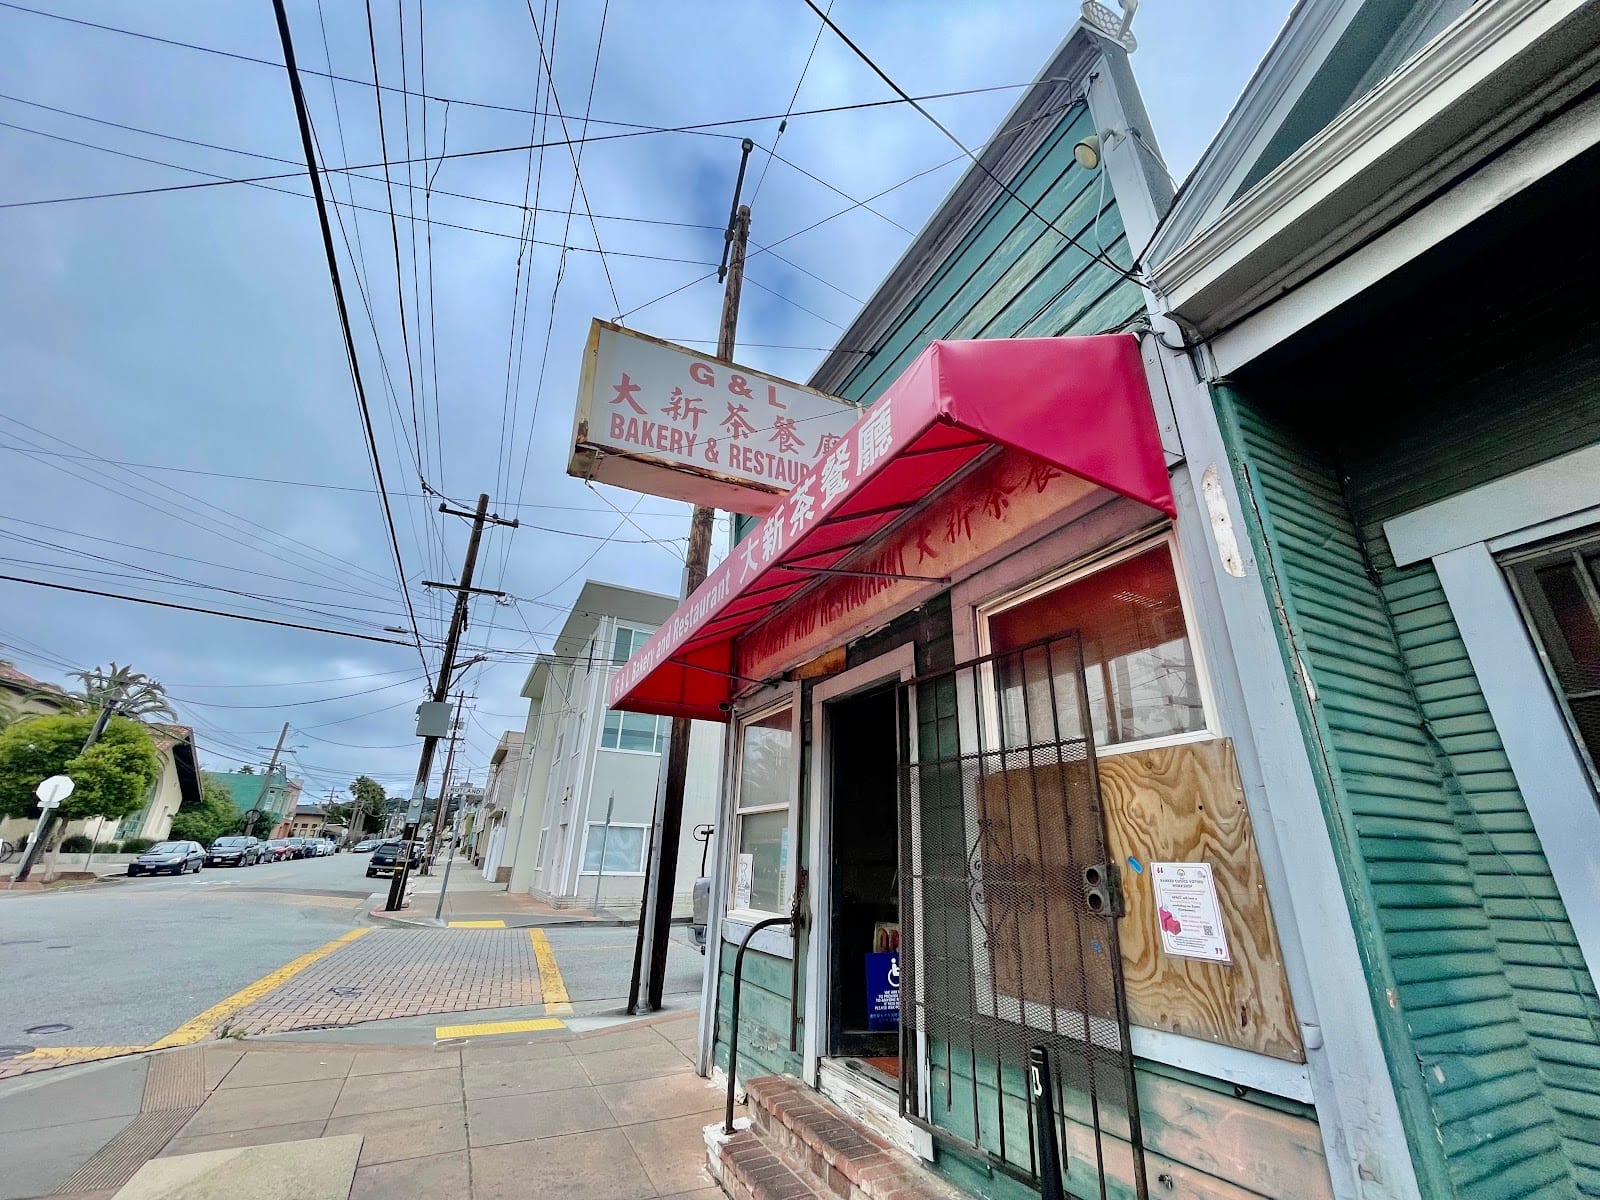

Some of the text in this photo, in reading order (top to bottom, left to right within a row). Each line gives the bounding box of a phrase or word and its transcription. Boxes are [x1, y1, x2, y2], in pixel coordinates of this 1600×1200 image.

[689, 362, 787, 409] G & L
[610, 412, 697, 458] BAKERY
[704, 438, 720, 464] &
[631, 647, 655, 682] Bakery
[656, 624, 672, 659] and
[672, 567, 731, 643] Restaurant
